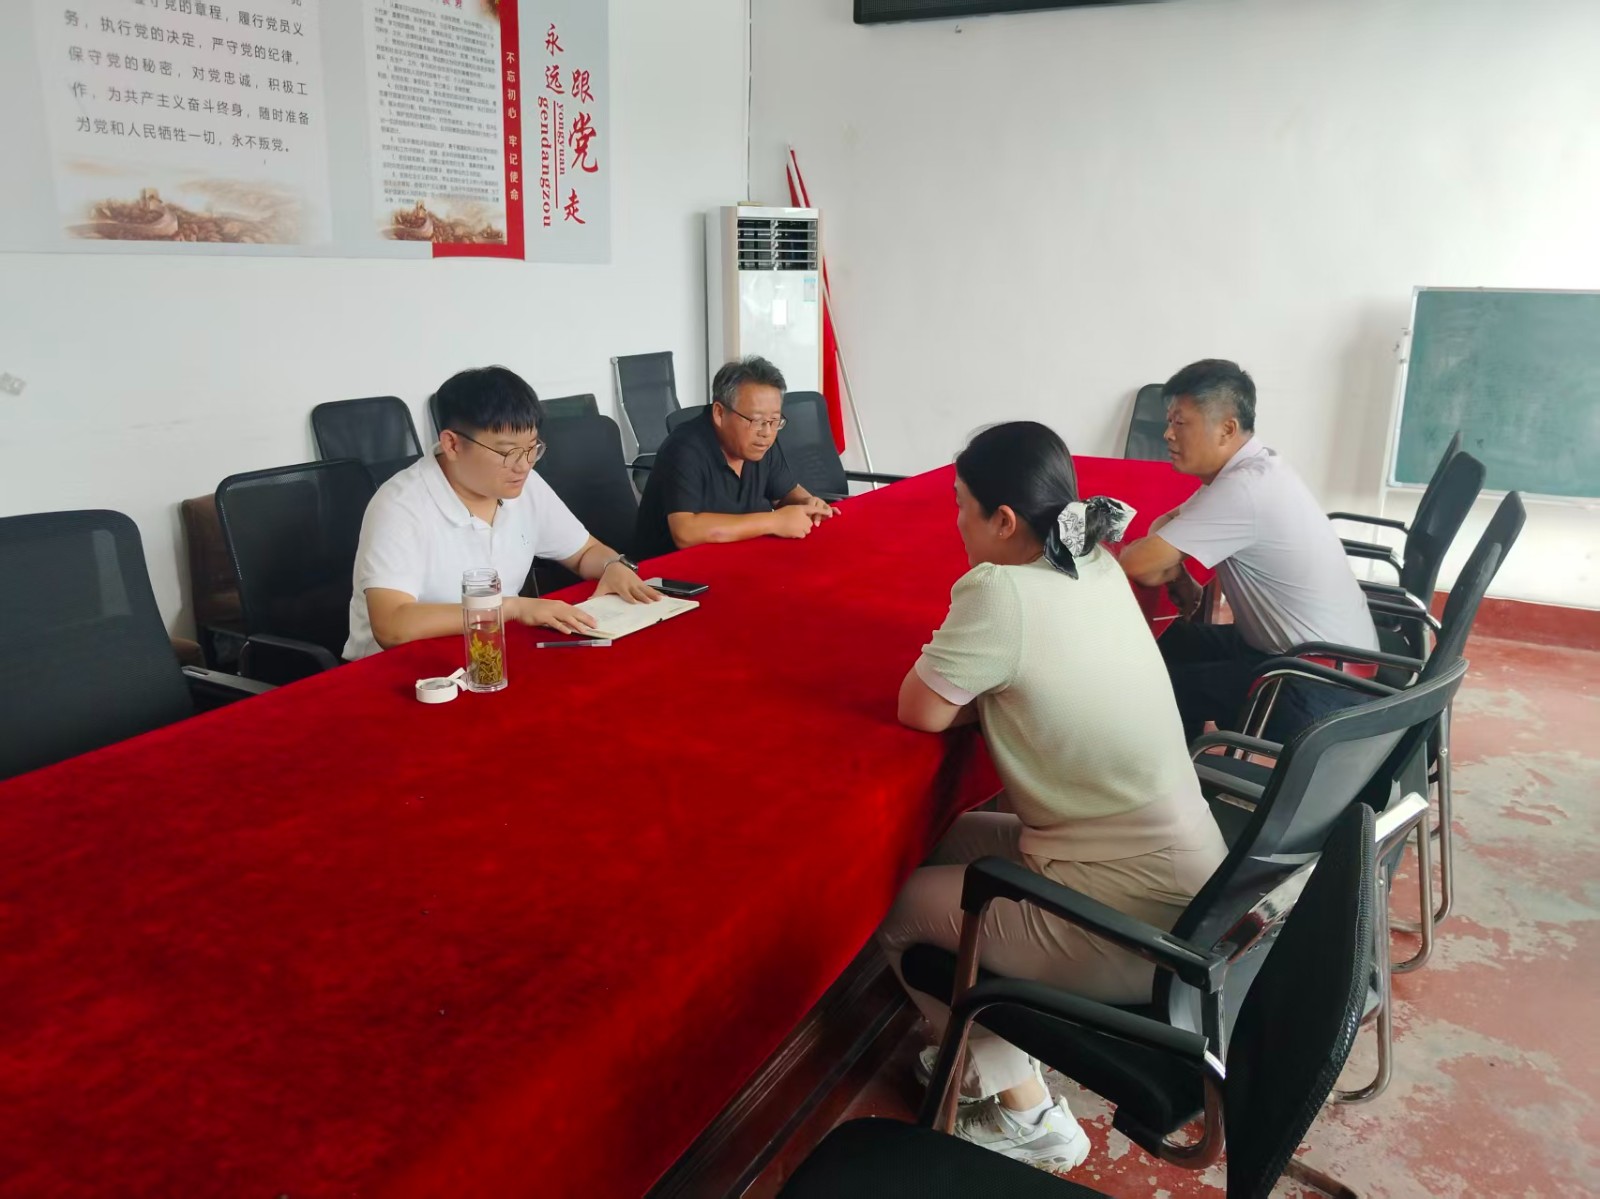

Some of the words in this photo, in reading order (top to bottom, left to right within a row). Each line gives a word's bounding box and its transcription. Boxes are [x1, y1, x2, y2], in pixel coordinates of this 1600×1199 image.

[135, 0, 304, 37] 党的章程，履行党员义
[506, 52, 517, 119] 不忘初心
[545, 23, 564, 94] 永远
[508, 135, 519, 201] 牢记使命
[538, 96, 552, 227] gendangzou
[556, 102, 565, 175] yongyuan
[564, 69, 599, 224] 跟党走
